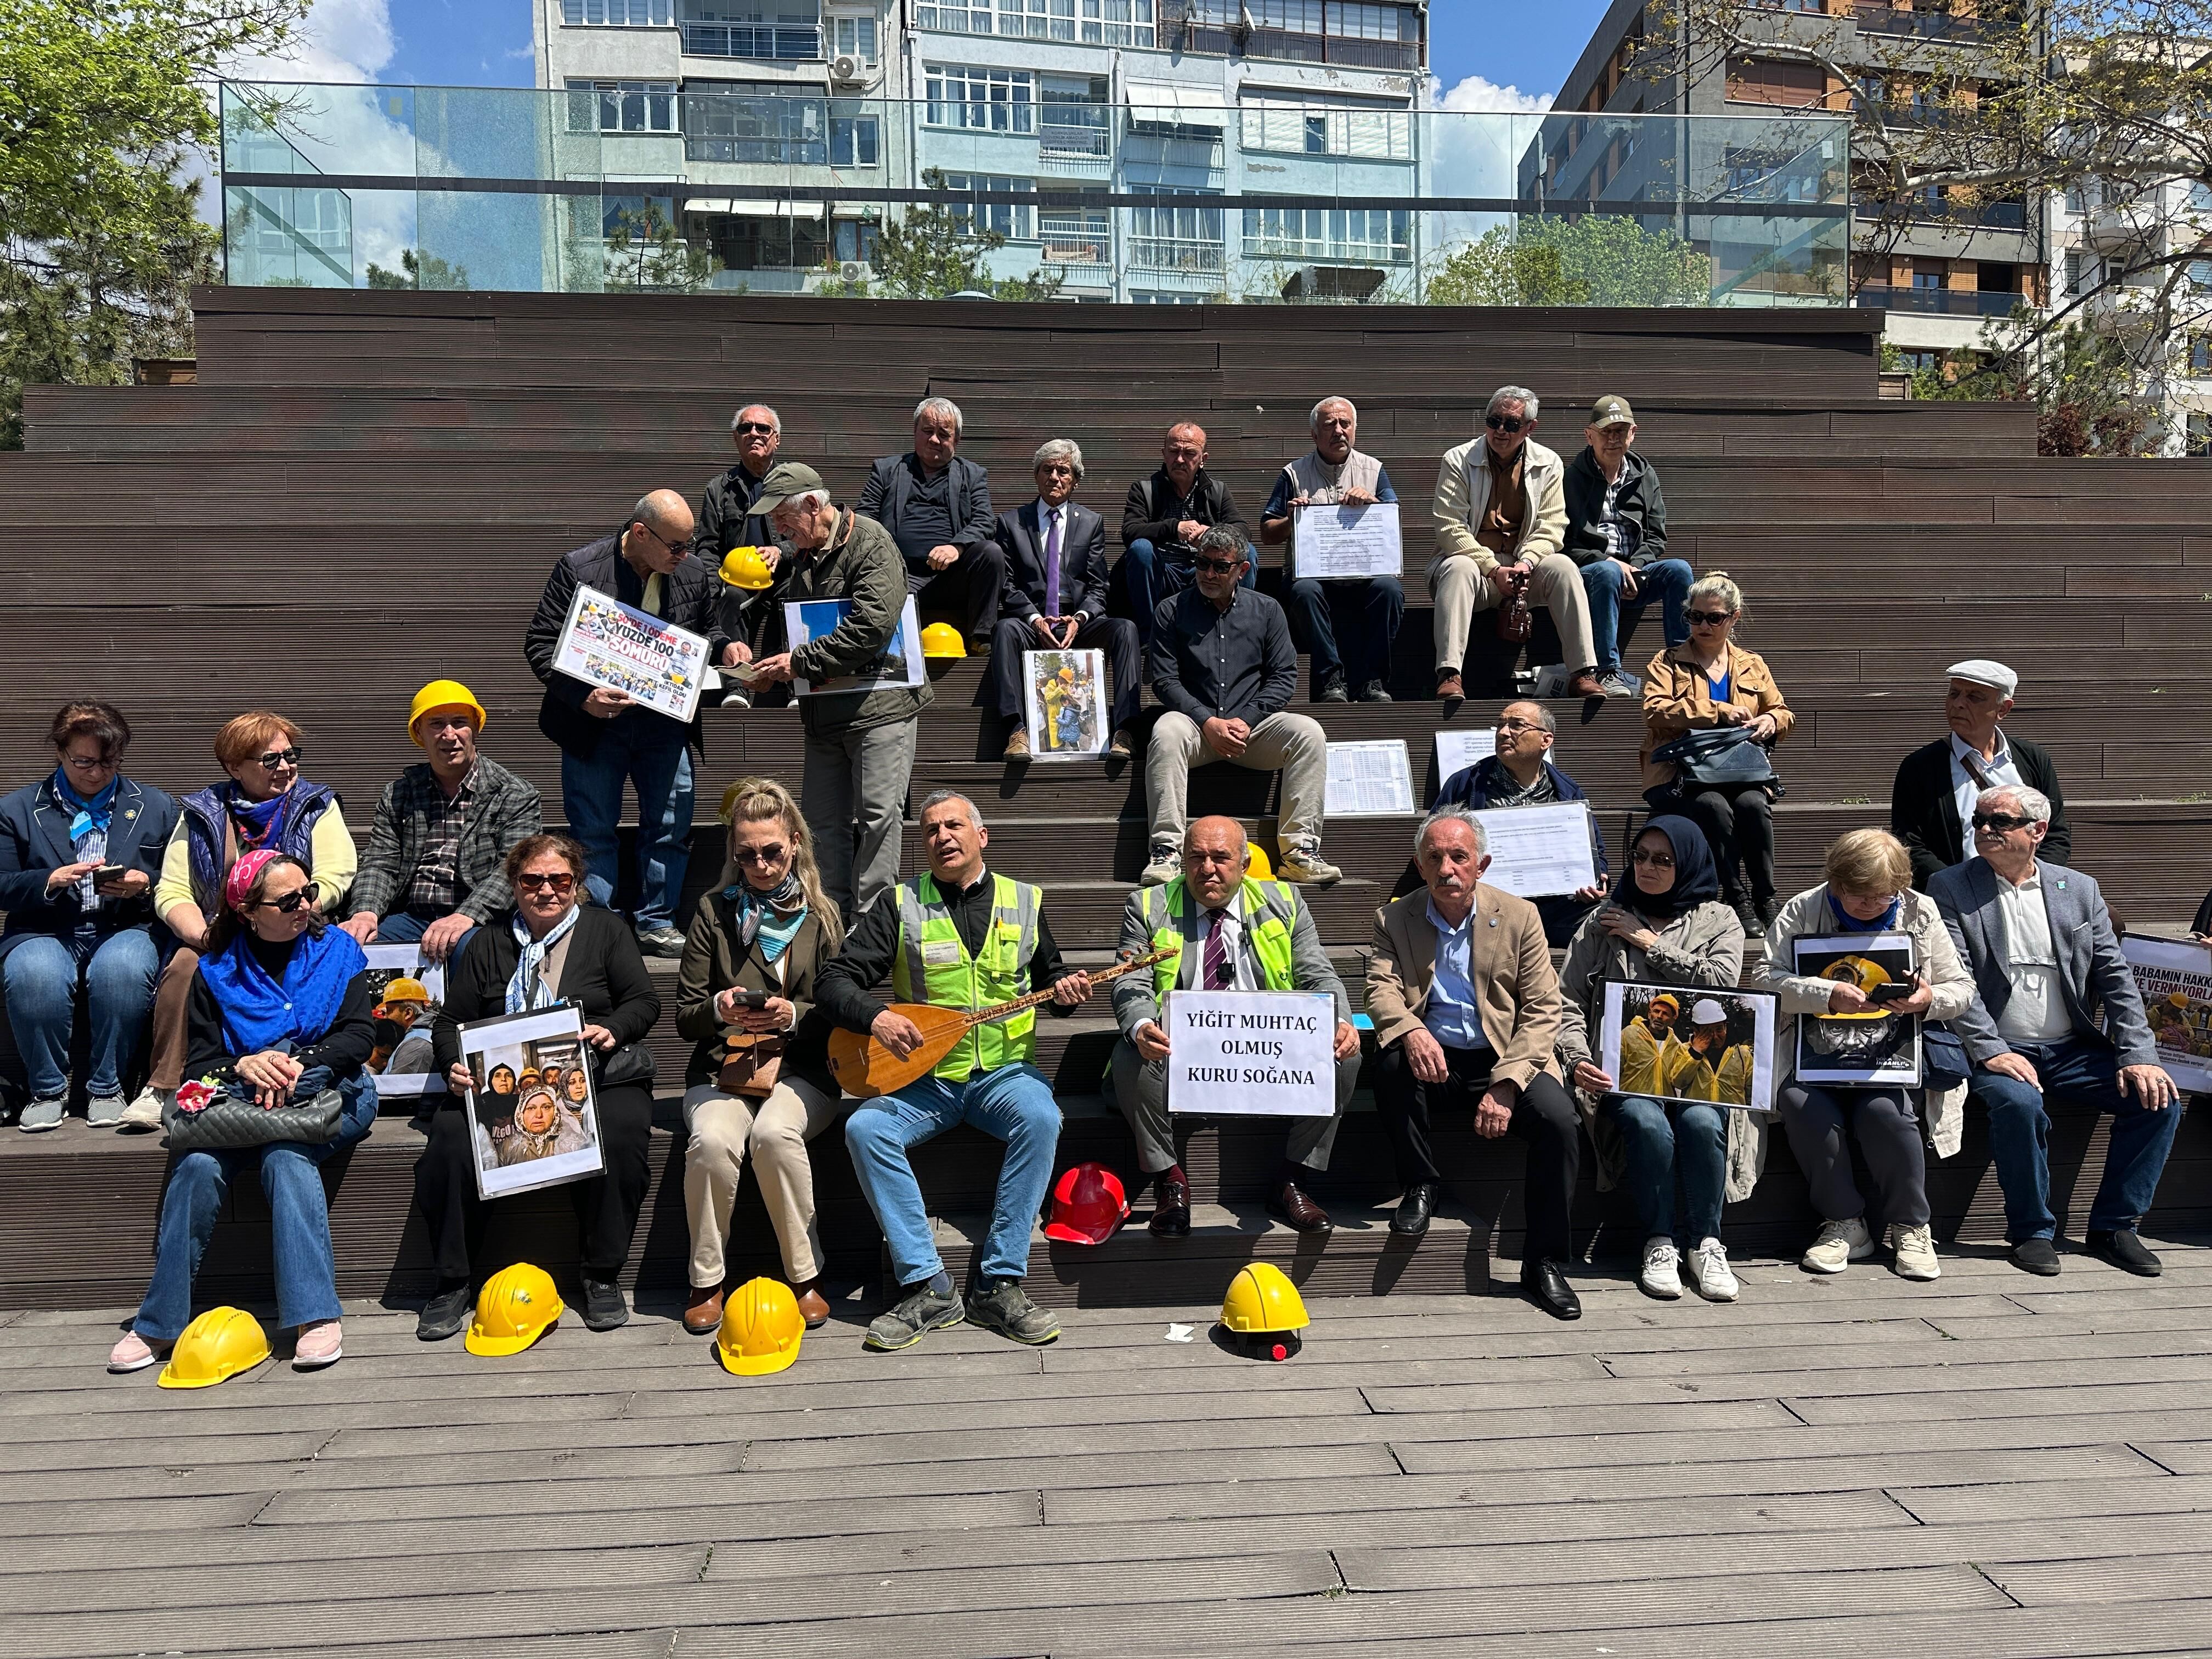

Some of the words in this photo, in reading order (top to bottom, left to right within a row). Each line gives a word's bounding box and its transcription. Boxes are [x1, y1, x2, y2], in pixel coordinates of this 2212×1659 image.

[616, 623, 653, 648] YÜZDE
[654, 640, 674, 657] 100
[673, 689, 686, 698] OLDU
[2132, 965, 2181, 983] BABAMIN
[2183, 973, 2212, 988] HAKK
[1187, 1009, 1235, 1028] YİĞİT
[1240, 1015, 1317, 1034] MUHTAÇ
[1221, 1040, 1283, 1059] OLMUŞ
[1187, 1068, 1238, 1082] KURU
[1243, 1066, 1316, 1085] SOĞANA
